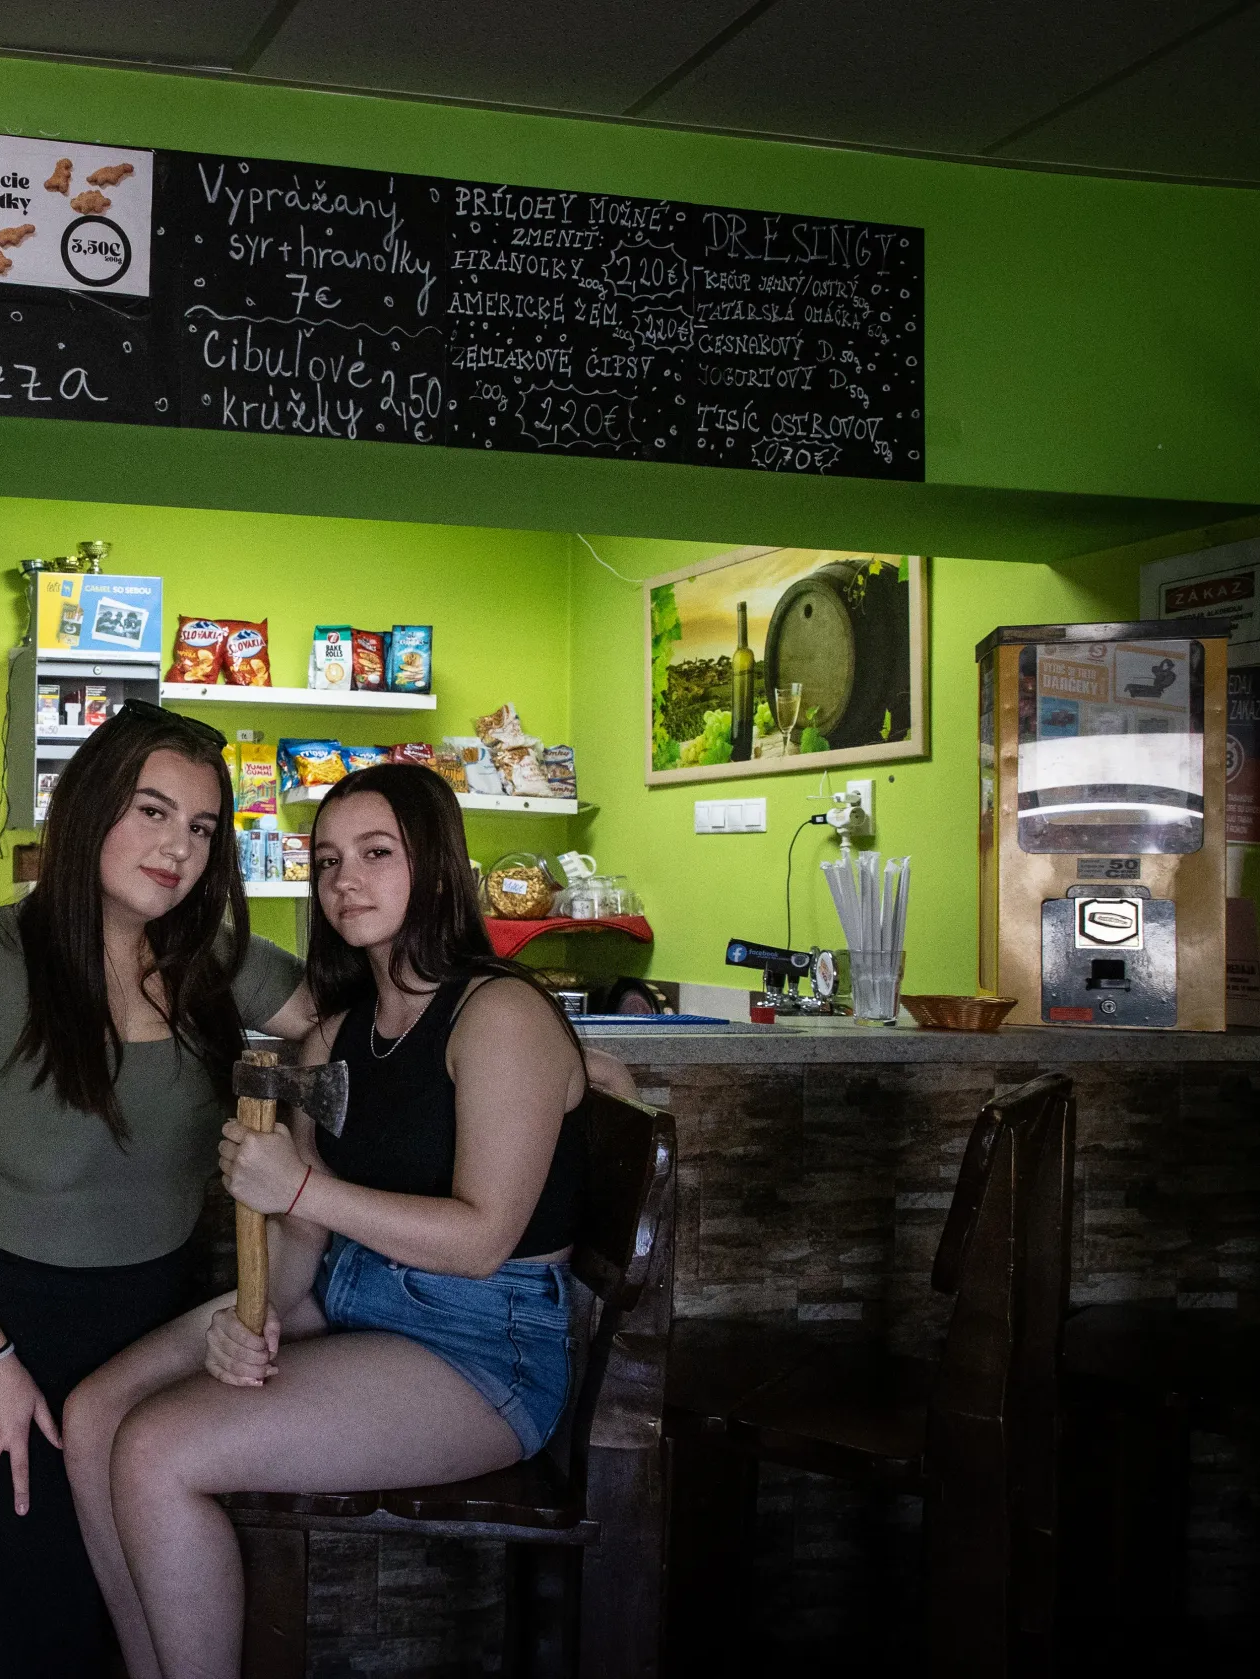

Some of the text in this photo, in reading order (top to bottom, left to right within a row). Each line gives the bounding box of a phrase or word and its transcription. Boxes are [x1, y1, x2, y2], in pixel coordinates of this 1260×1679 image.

[455, 184, 578, 224] PRÍLOHY
[451, 250, 585, 279] HRANOLKY
[697, 400, 761, 432] TISÍC
[771, 412, 884, 443] OSTROVOV
[245, 763, 272, 772] YUMMI
[246, 769, 273, 777] GUMMI
[1109, 859, 1139, 870] 50
[748, 948, 779, 958] facebook
